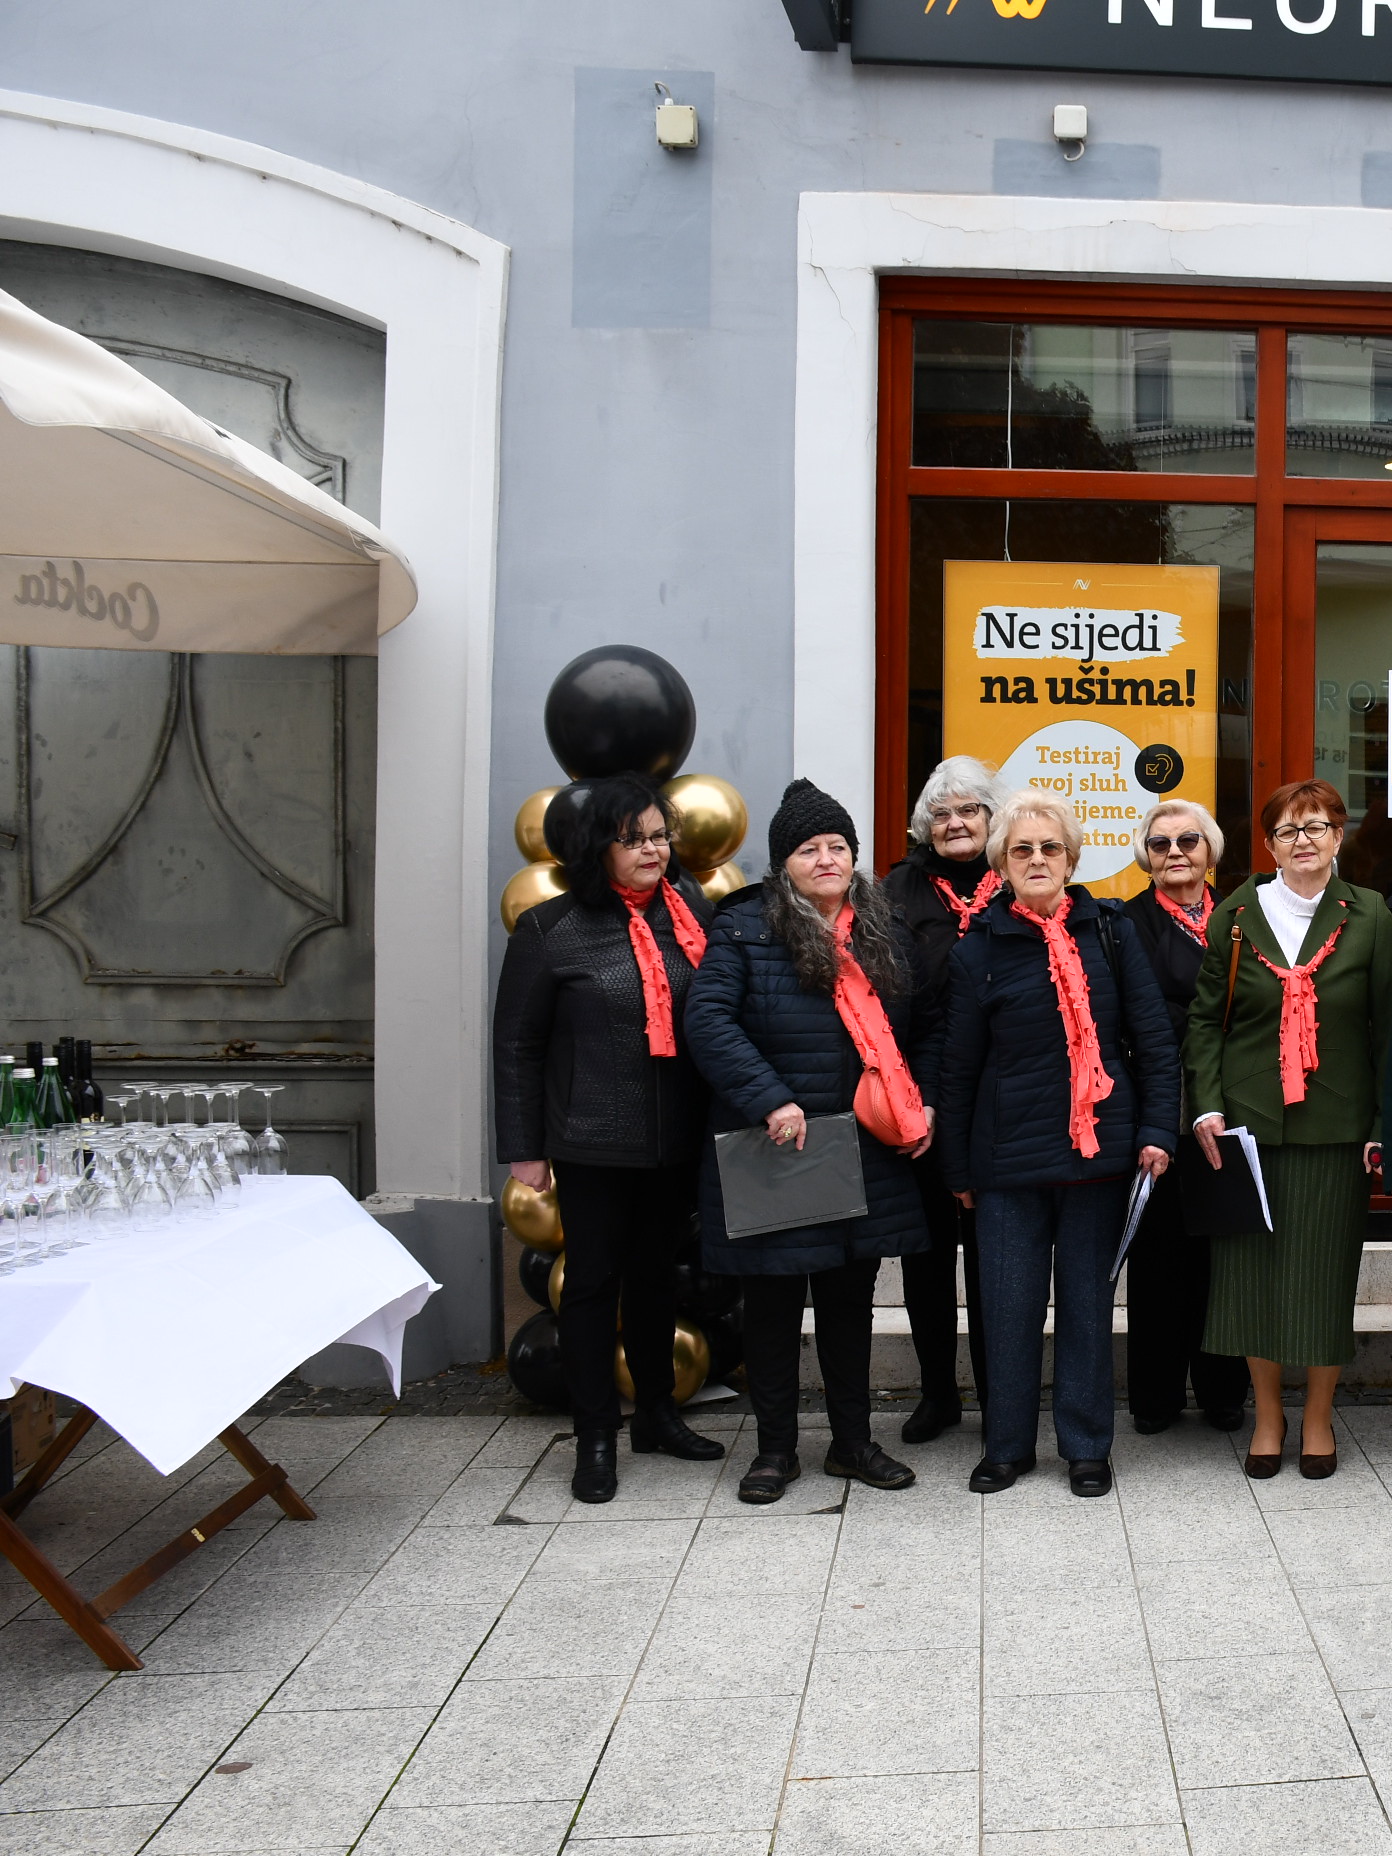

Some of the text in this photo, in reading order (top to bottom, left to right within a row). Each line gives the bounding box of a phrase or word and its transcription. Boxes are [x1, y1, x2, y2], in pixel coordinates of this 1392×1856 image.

[981, 613, 1162, 662] Ne sijedi
[980, 665, 1196, 707] na ušima!
[1036, 745, 1121, 770] Testiraj
[1029, 772, 1128, 797] svoj sluh
[1073, 800, 1143, 824] ijeme.
